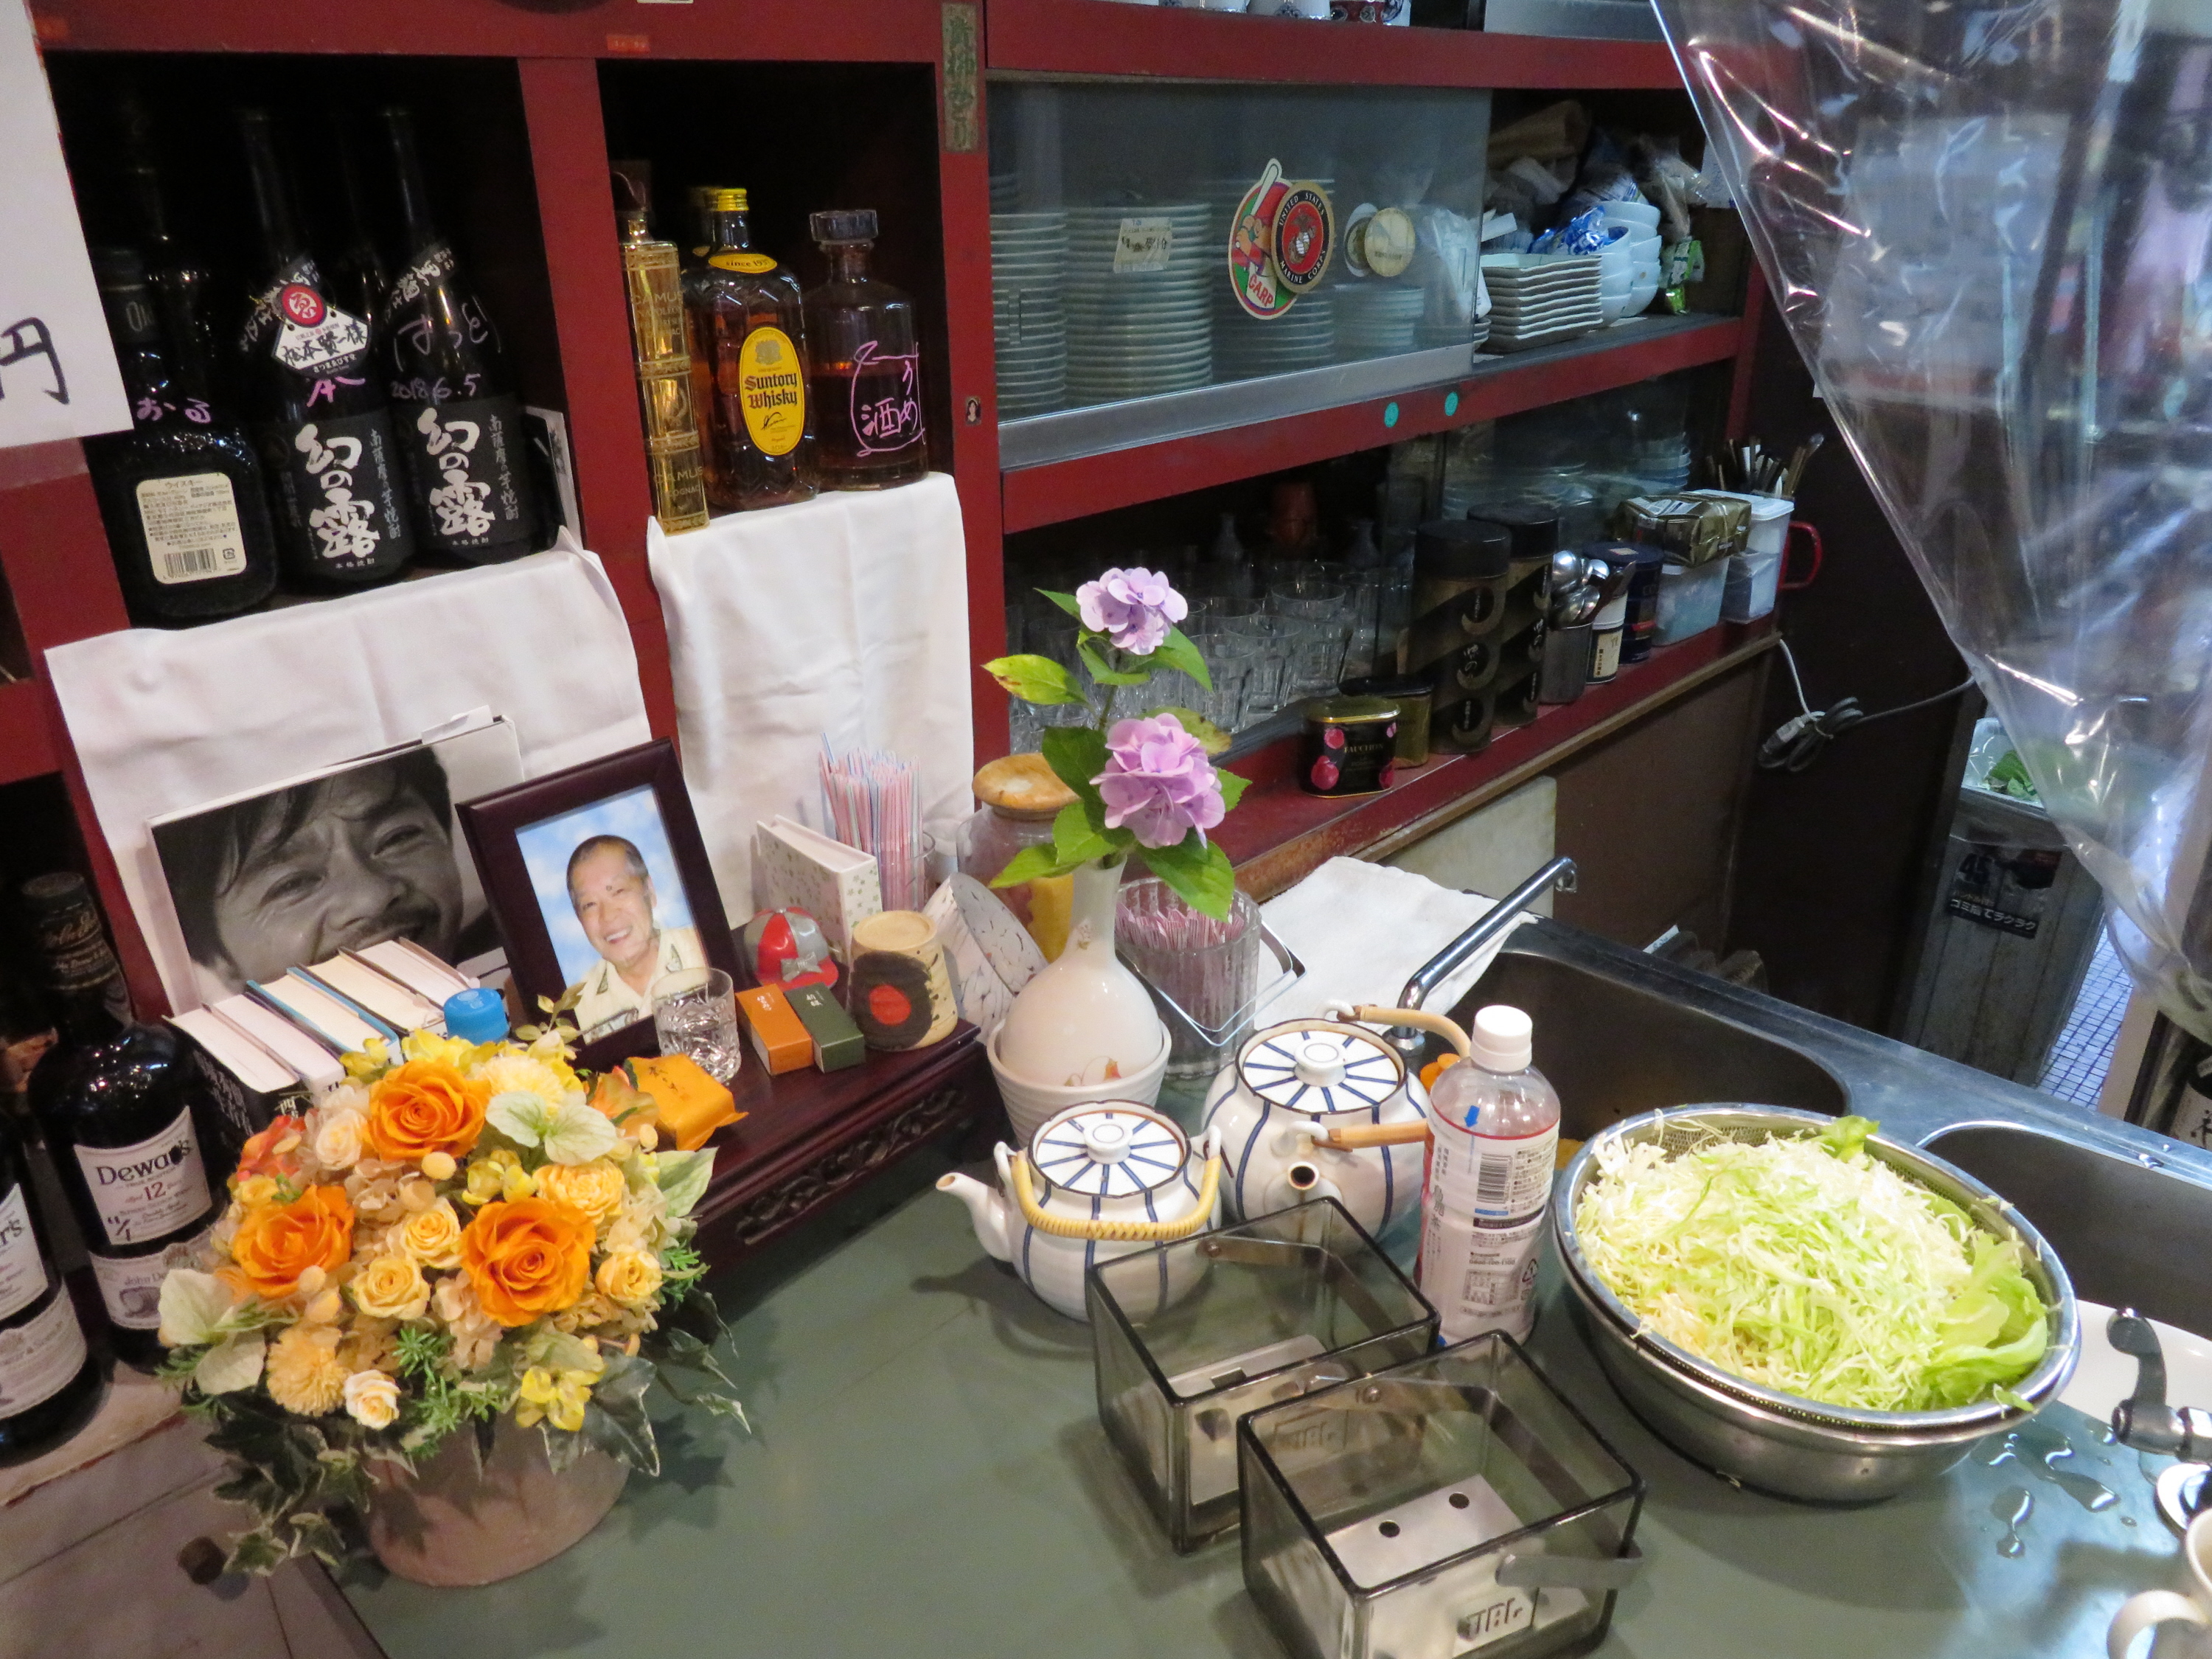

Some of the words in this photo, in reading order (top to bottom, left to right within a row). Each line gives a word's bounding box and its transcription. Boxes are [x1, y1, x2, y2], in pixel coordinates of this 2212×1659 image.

[1279, 195, 1299, 226] UNITED
[1304, 192, 1326, 216] STATES
[1279, 260, 1304, 285] MARINE
[1307, 249, 1326, 280] CORPS
[1248, 274, 1274, 307] CARP
[744, 372, 798, 392] Suntory
[746, 389, 798, 410] Whisky
[860, 397, 901, 439] 酒
[417, 407, 496, 537] 幻の露
[295, 423, 381, 559] 幻の露
[95, 1138, 192, 1186] Dewa's
[144, 1181, 167, 1201] 12
